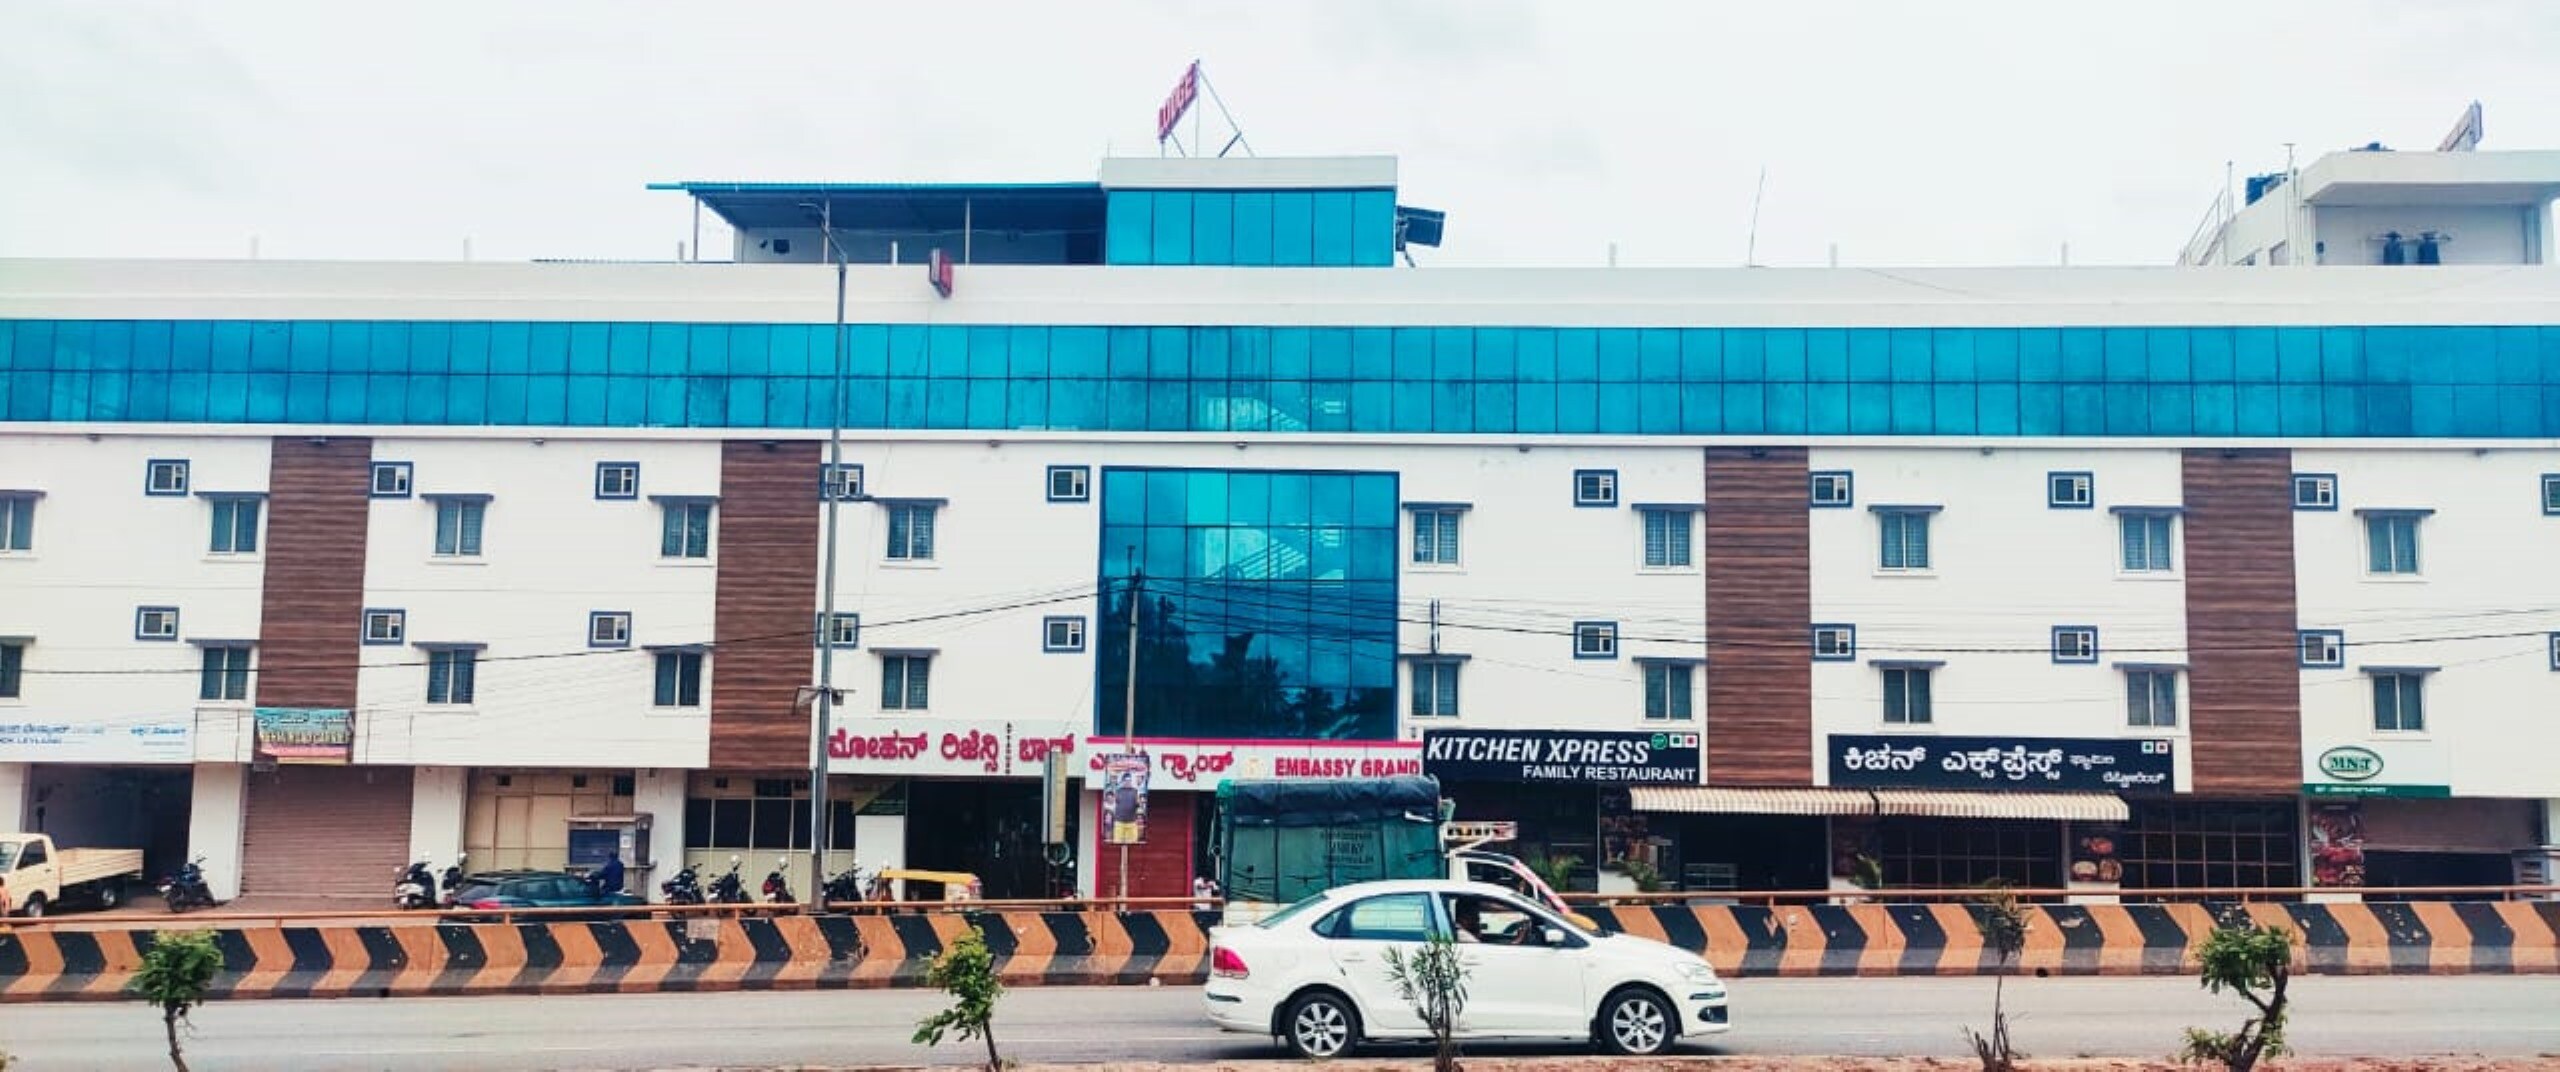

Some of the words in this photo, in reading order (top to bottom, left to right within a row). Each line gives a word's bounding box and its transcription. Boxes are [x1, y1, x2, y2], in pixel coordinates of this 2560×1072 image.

[1427, 737, 1541, 762] KITCHEN
[1545, 740, 1651, 764] XPRESS
[1843, 743, 1927, 771] ಕಿಚನ್
[1275, 757, 1356, 777] EMBASSY
[1361, 758, 1420, 777] GRAND
[1523, 765, 1581, 779] FAMILY
[1585, 766, 1697, 782] RESTAURANT
